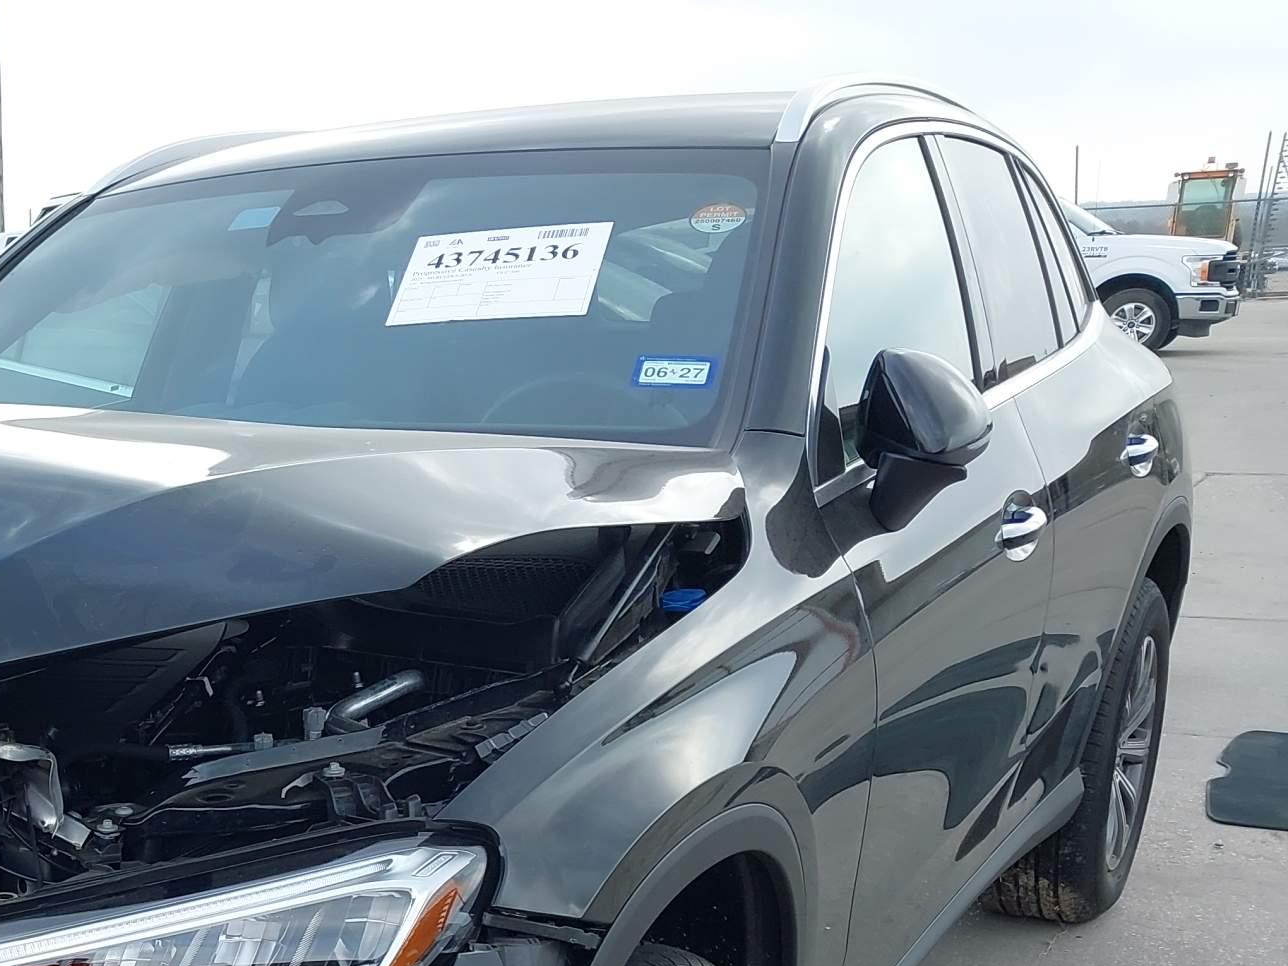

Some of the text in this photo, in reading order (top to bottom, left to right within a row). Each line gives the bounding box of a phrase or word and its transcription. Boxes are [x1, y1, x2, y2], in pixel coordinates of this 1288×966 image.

[428, 244, 580, 269] 43745136
[644, 366, 705, 379] 06 27
